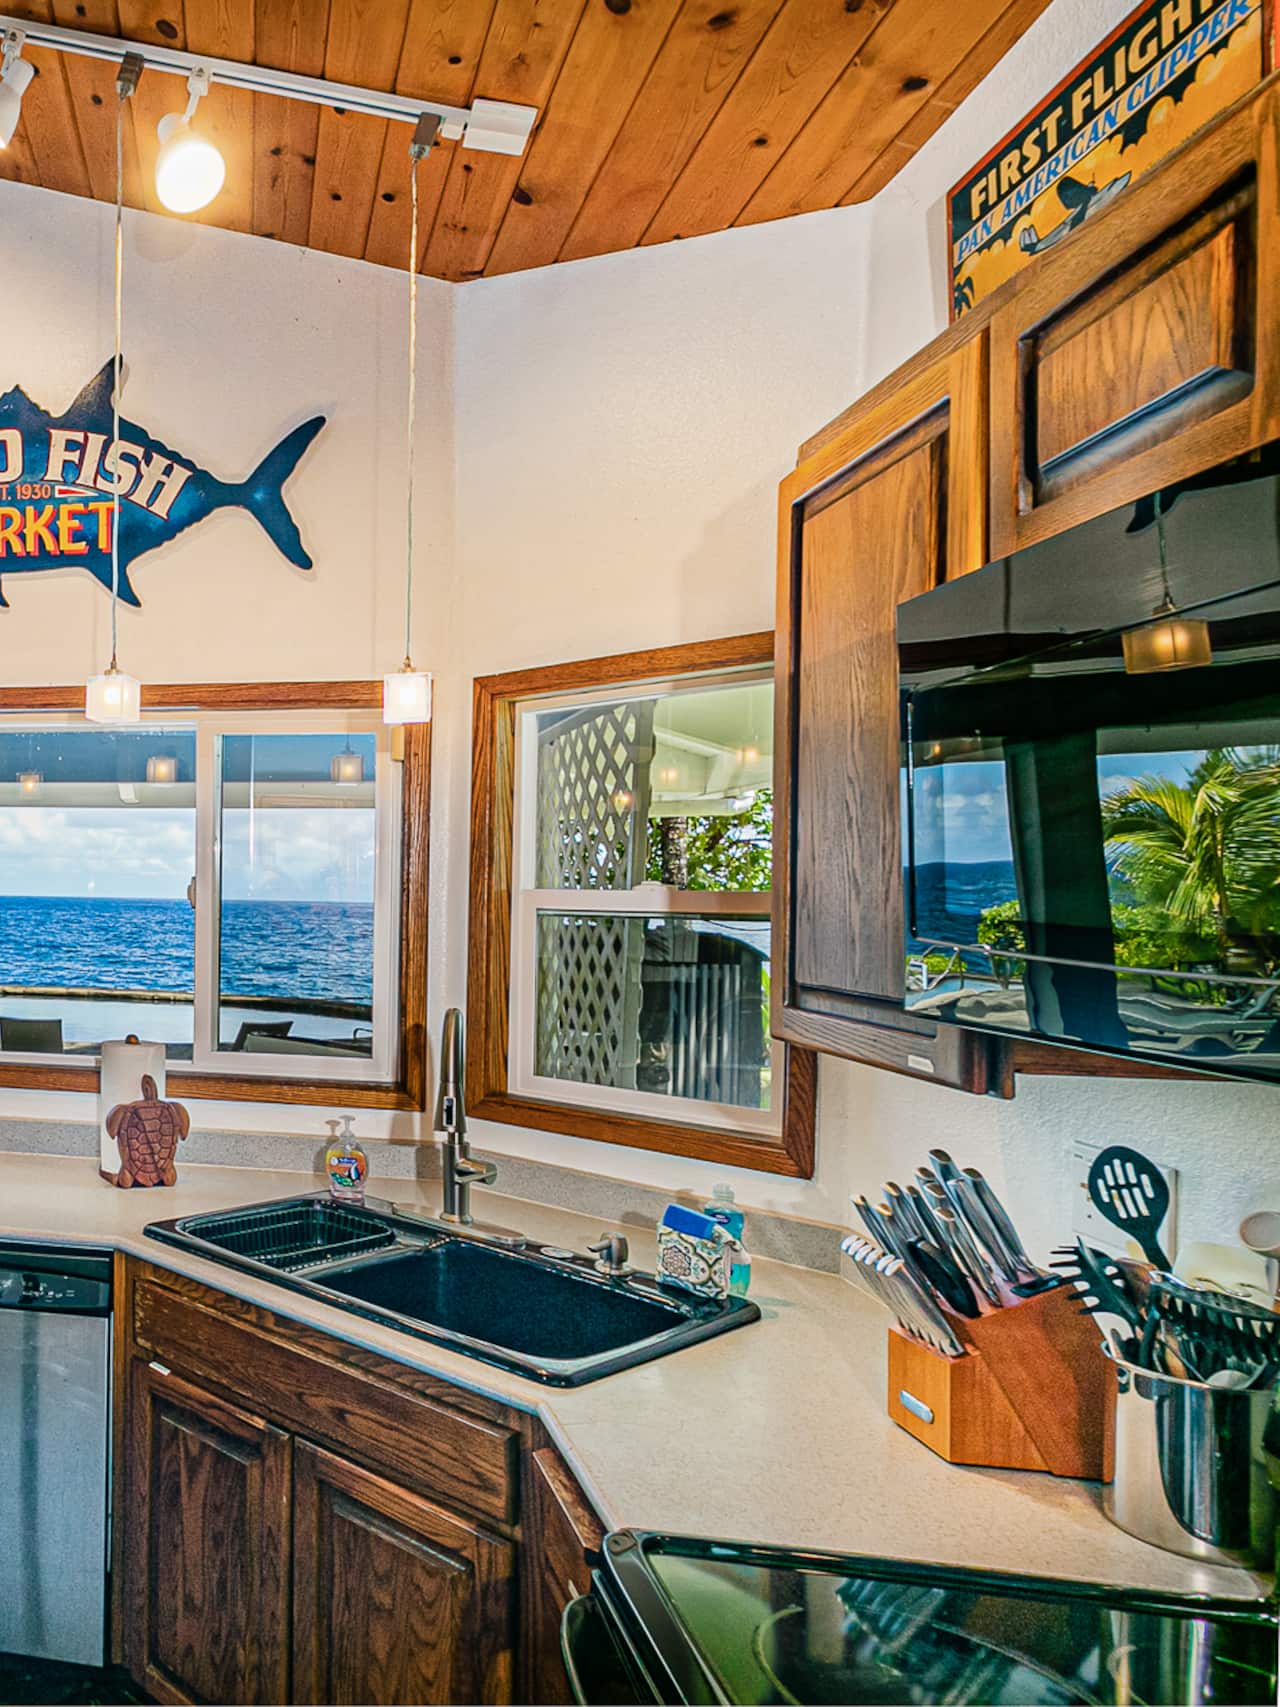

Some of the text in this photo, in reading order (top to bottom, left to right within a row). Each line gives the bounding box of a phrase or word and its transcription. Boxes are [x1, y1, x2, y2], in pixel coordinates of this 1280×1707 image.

[956, 0, 1252, 262] PAN AMERICAN CLIPPER
[970, 105, 1063, 222] FIRST
[15, 483, 51, 500] 1930
[45, 427, 194, 520] FISH
